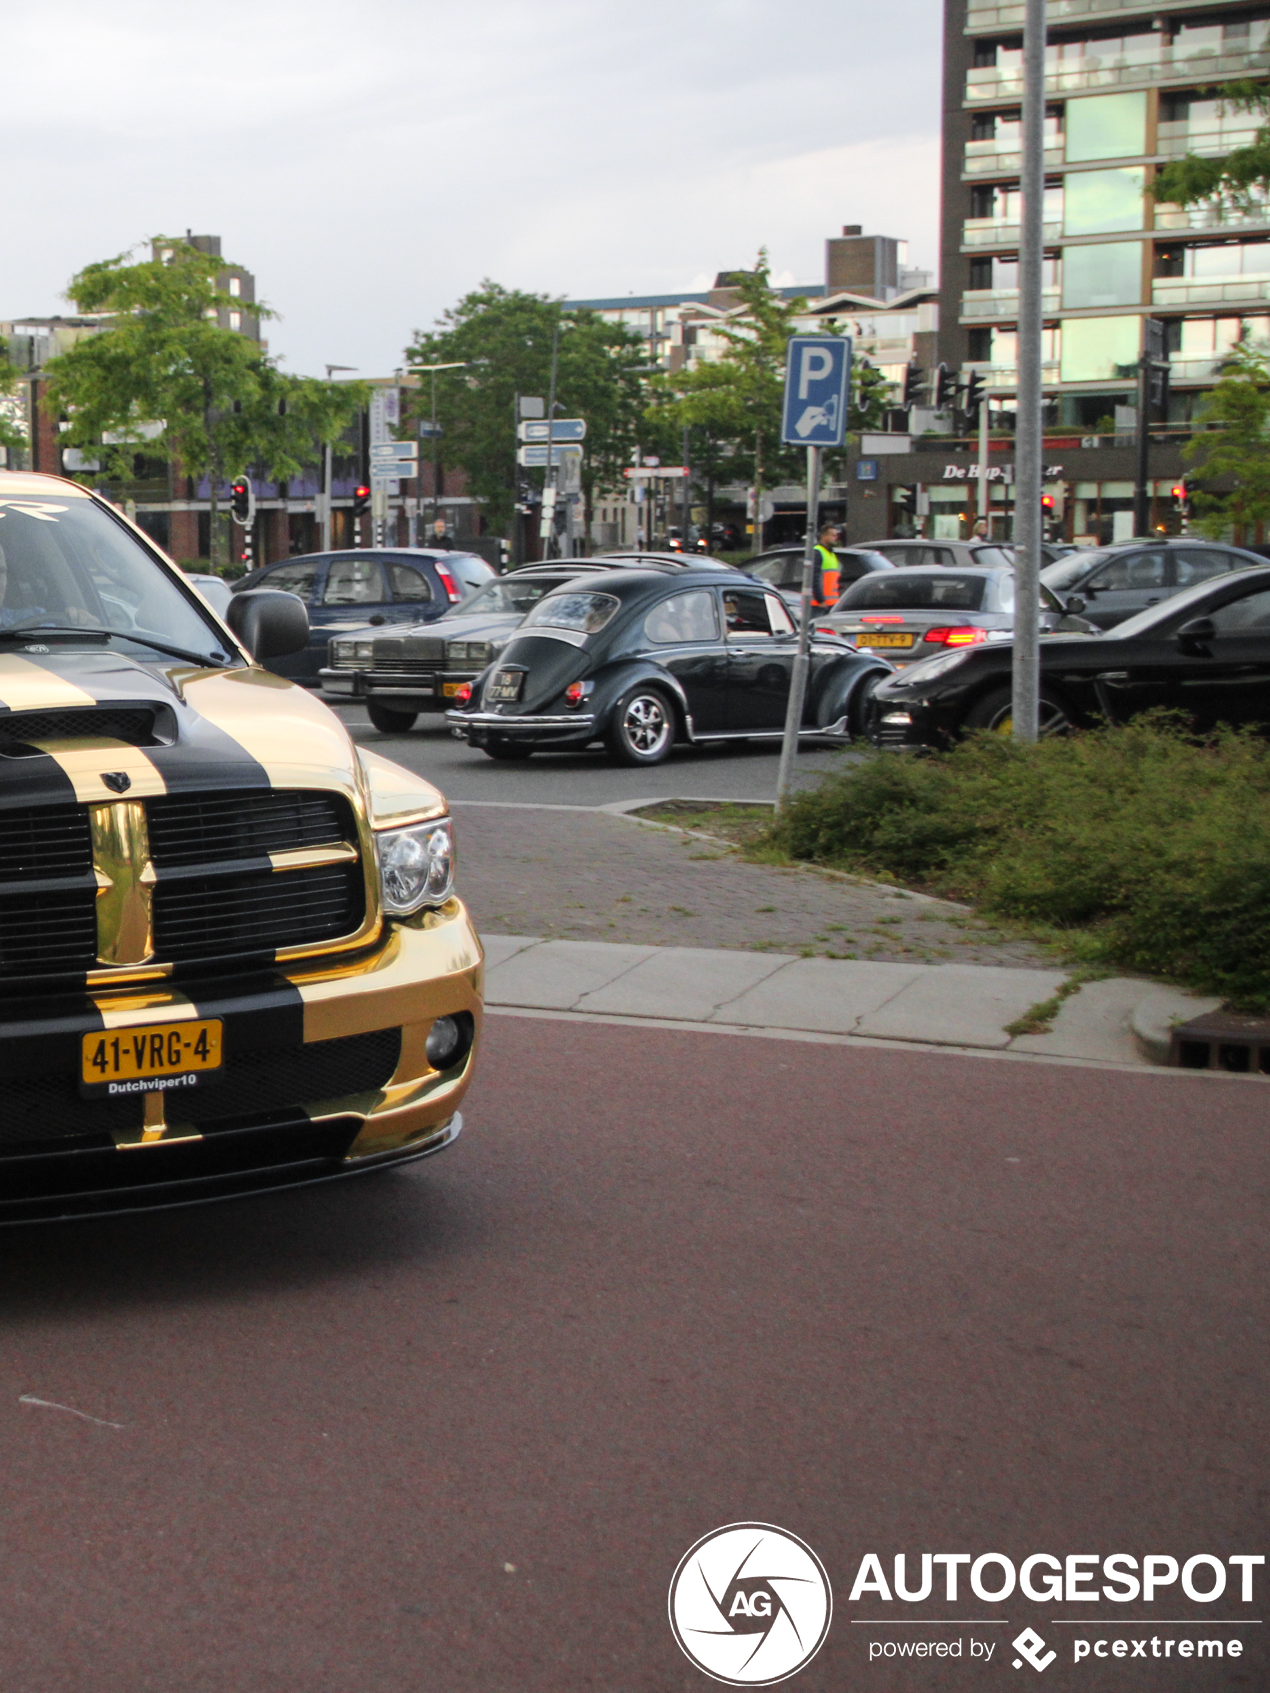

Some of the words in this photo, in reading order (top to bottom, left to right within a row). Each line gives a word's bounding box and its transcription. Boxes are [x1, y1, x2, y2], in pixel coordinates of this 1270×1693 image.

[798, 346, 834, 400] P
[943, 464, 966, 479] De
[91, 1027, 210, 1074] 41-VRG-4
[108, 1074, 197, 1094] Dutchviper10
